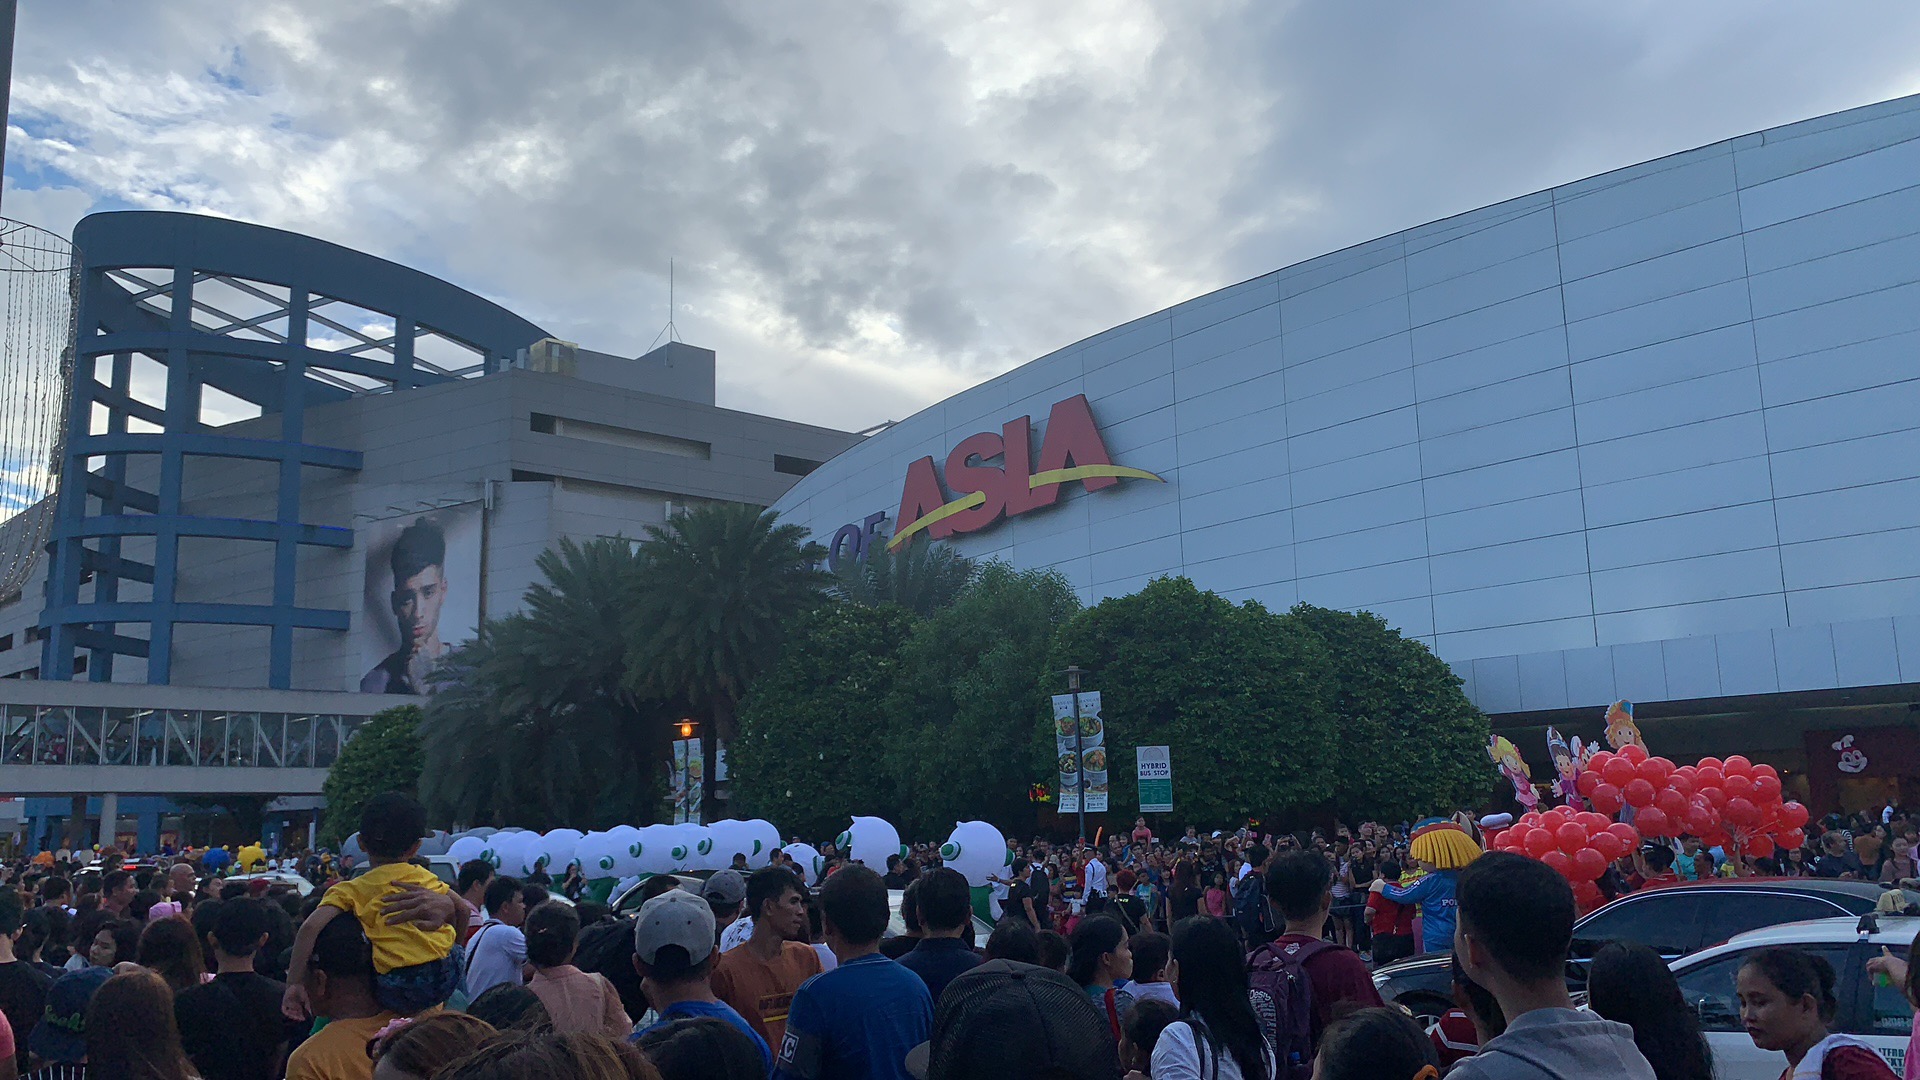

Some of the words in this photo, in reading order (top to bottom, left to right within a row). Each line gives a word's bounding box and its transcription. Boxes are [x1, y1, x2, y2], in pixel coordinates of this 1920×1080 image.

[829, 511, 886, 573] OF
[890, 394, 1118, 552] ASIA
[1141, 762, 1167, 770] HYBRID
